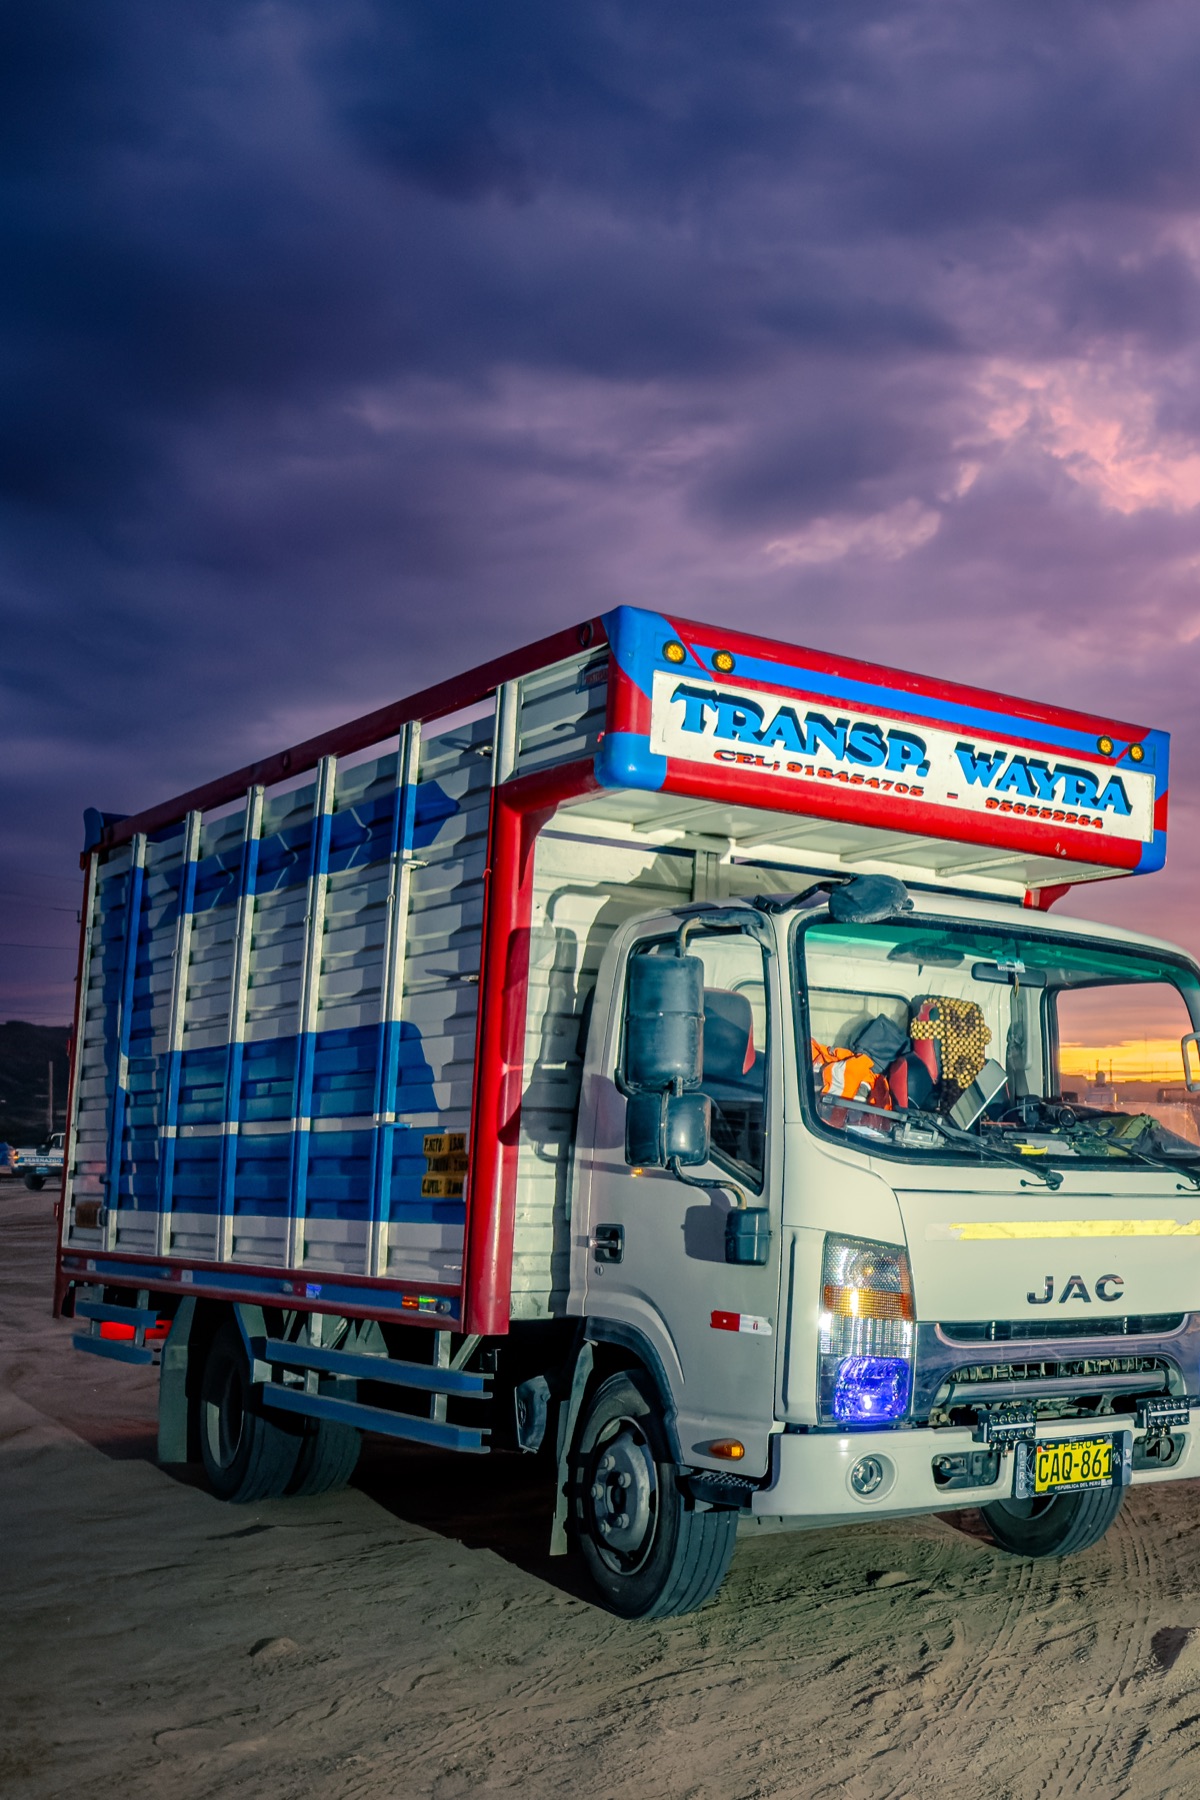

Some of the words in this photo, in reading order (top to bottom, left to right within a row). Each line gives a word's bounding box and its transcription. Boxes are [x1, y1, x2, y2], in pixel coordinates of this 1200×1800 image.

[670, 683, 931, 777] TRANSP.
[954, 741, 1133, 816] WAYRA
[1026, 1273, 1125, 1304] JAC
[1038, 1447, 1112, 1483] CAQ-861
